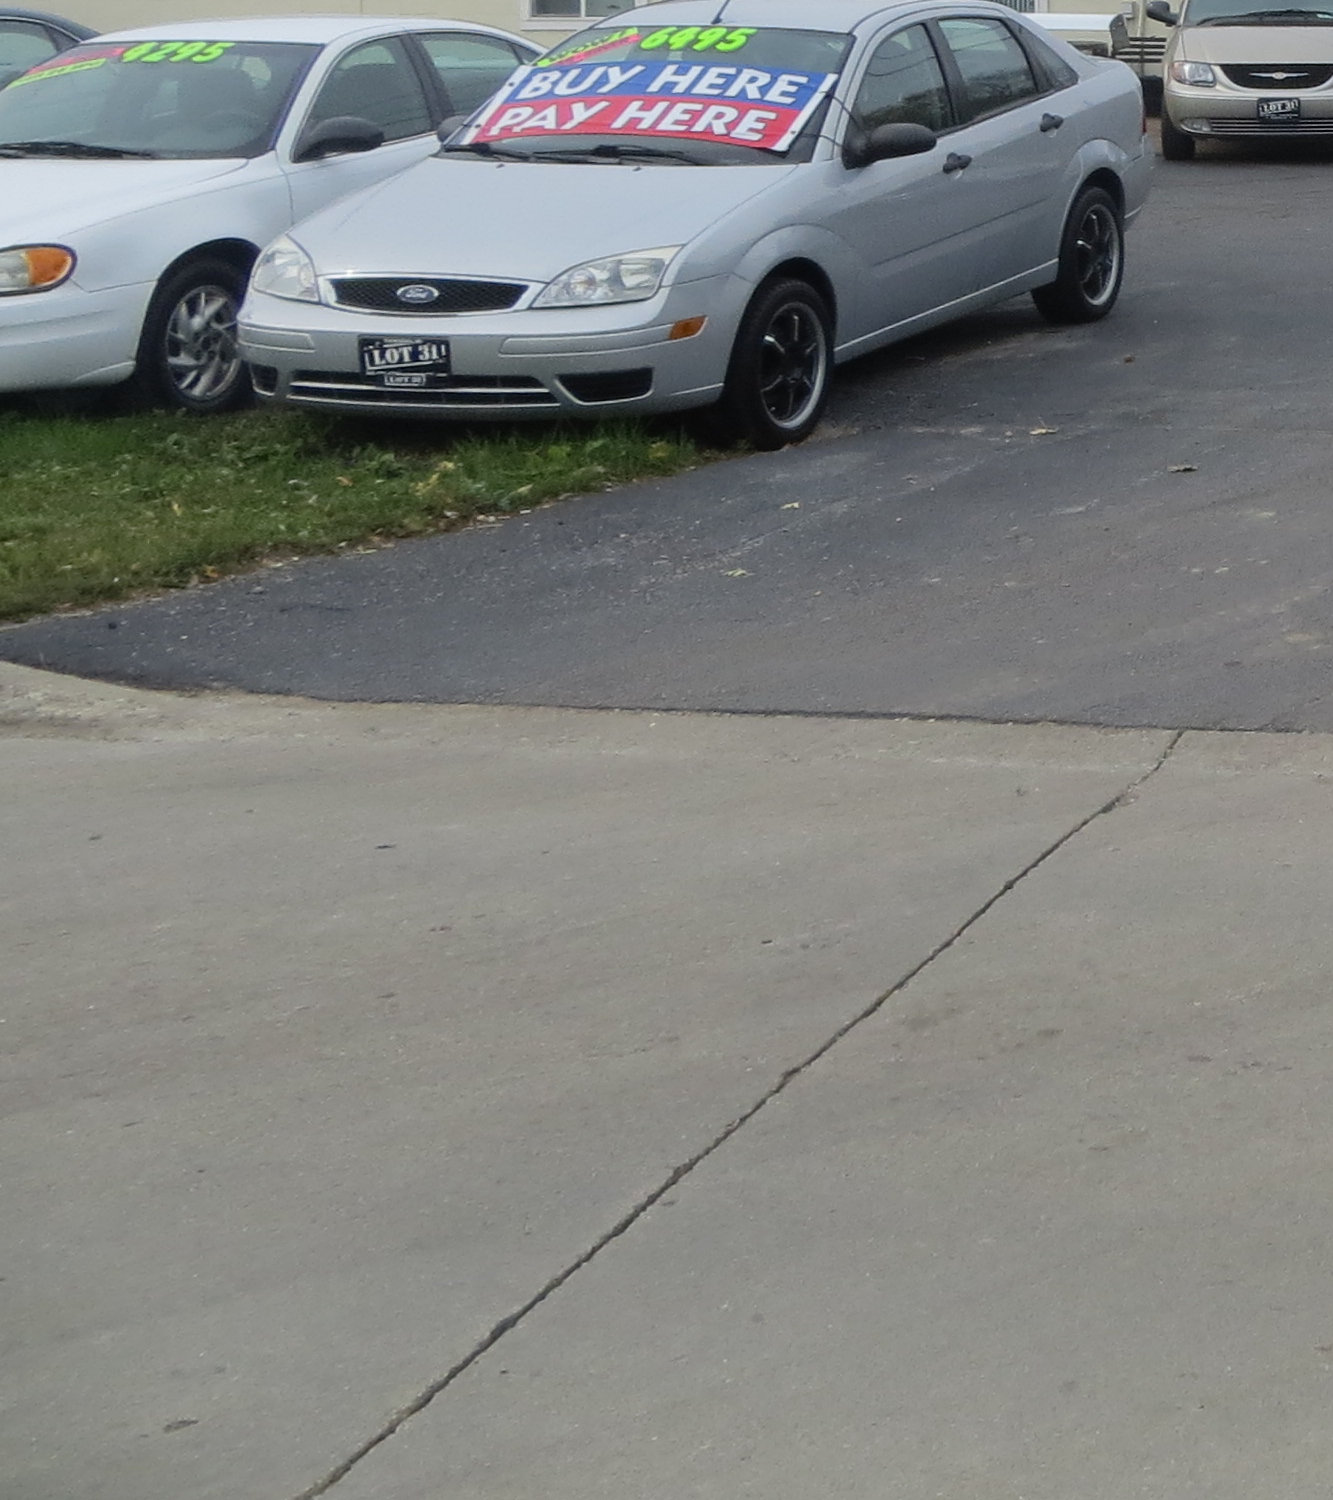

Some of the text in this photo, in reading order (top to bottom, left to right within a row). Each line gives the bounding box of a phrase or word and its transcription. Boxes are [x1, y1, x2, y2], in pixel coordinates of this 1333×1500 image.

[640, 26, 758, 52] 6495
[516, 64, 809, 105] BUY HERE
[487, 100, 778, 142] PAY HERE
[372, 344, 440, 366] LOT 31
